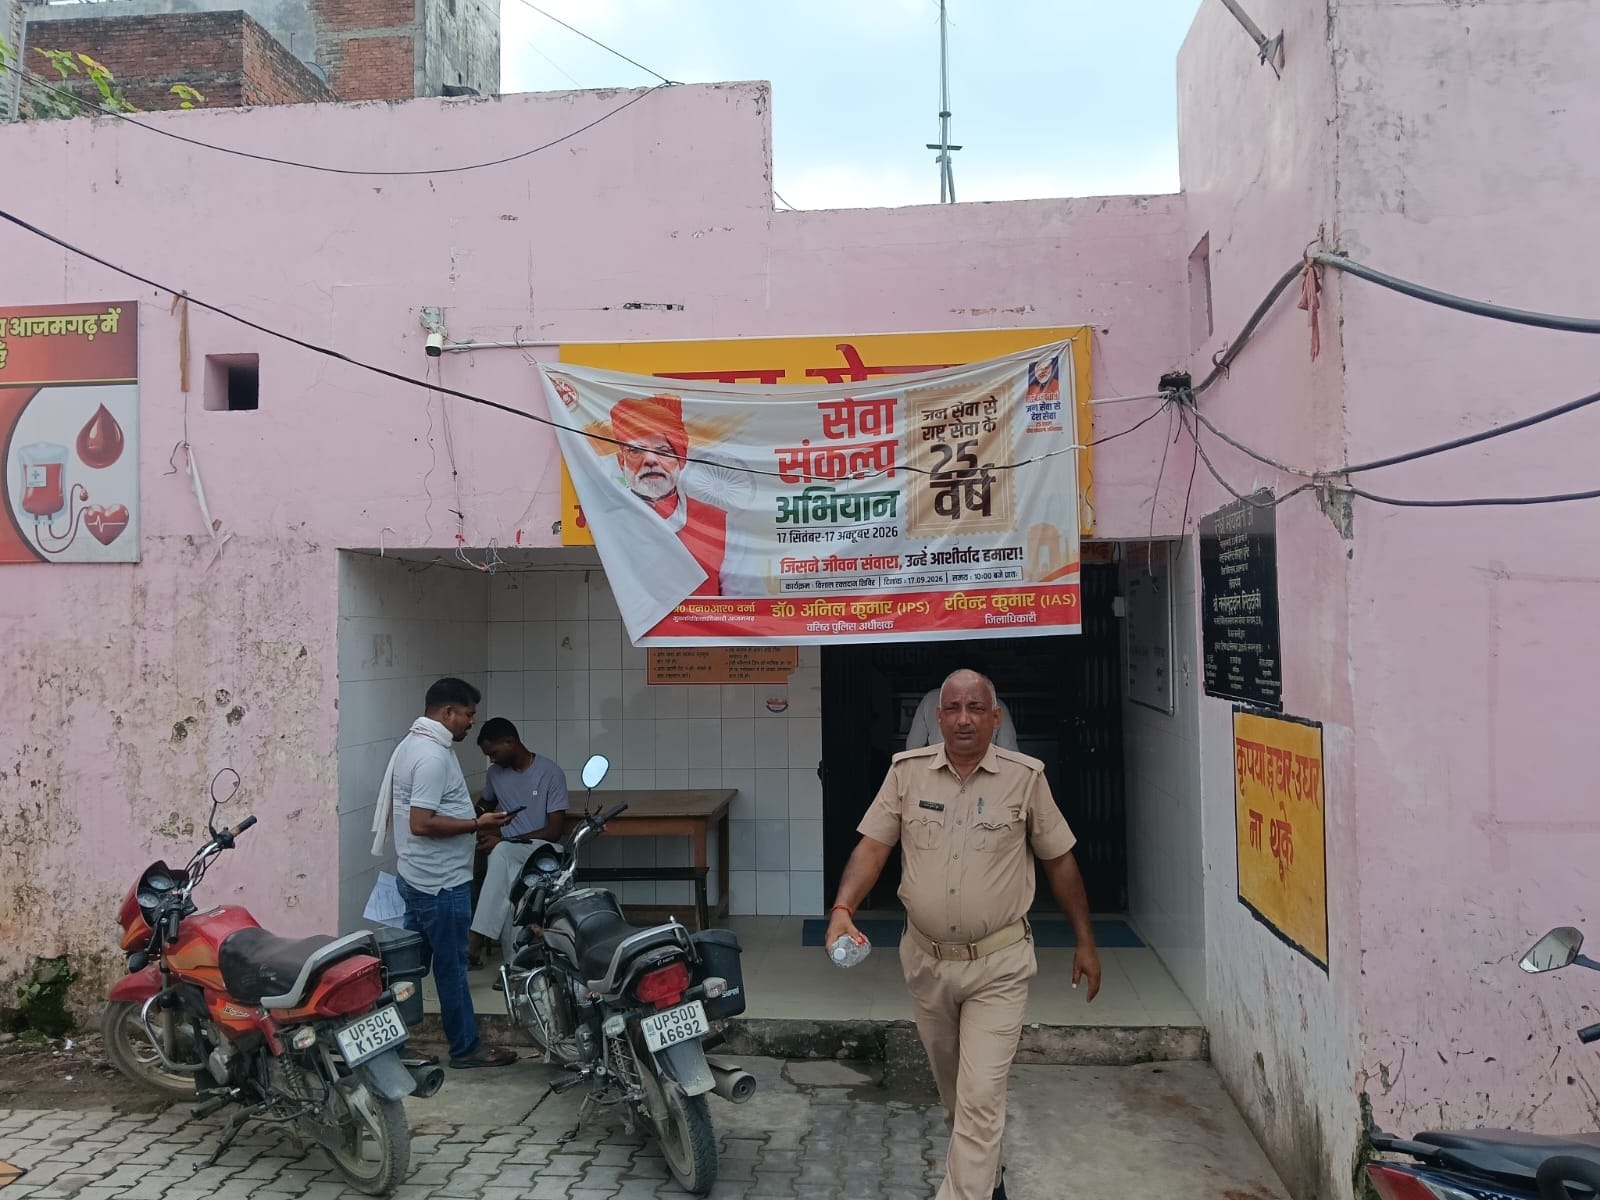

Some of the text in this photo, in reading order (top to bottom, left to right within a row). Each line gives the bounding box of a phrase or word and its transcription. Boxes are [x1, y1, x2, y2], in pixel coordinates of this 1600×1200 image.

[10, 314, 98, 341] आजमगढ़
[100, 307, 122, 333] में
[818, 397, 898, 440] सेवा
[921, 395, 999, 421] जन सेवा से
[950, 418, 980, 438] सेवा
[982, 416, 997, 433] के
[774, 438, 899, 484] संकल्प
[930, 439, 979, 480] 25
[775, 486, 900, 525] अभियान
[930, 463, 997, 519] वर्ष
[777, 532, 787, 543] 17
[837, 528, 870, 543] अक्टूबर
[872, 526, 899, 539] 2026
[780, 545, 1024, 574] जिसने जीवन संवारा, उन्हें आशीर्वाद हमारा!
[908, 574, 944, 584] 17.09.2026
[801, 599, 846, 617] अनिल
[850, 599, 893, 620] कुमार
[897, 601, 930, 616] (IPS)
[944, 591, 1077, 612] रविन्द्र कुमार (IAS)
[806, 618, 894, 633] वरिष्ठ पुलिस अधीक्षक
[984, 611, 1037, 625] जिलाधिकारी
[1236, 736, 1266, 797] कृपया
[1249, 807, 1263, 854] ना
[349, 1011, 392, 1041] UP50C
[653, 1004, 697, 1031] UP50D
[355, 1024, 399, 1055] K1520
[659, 1019, 702, 1046] A6692
